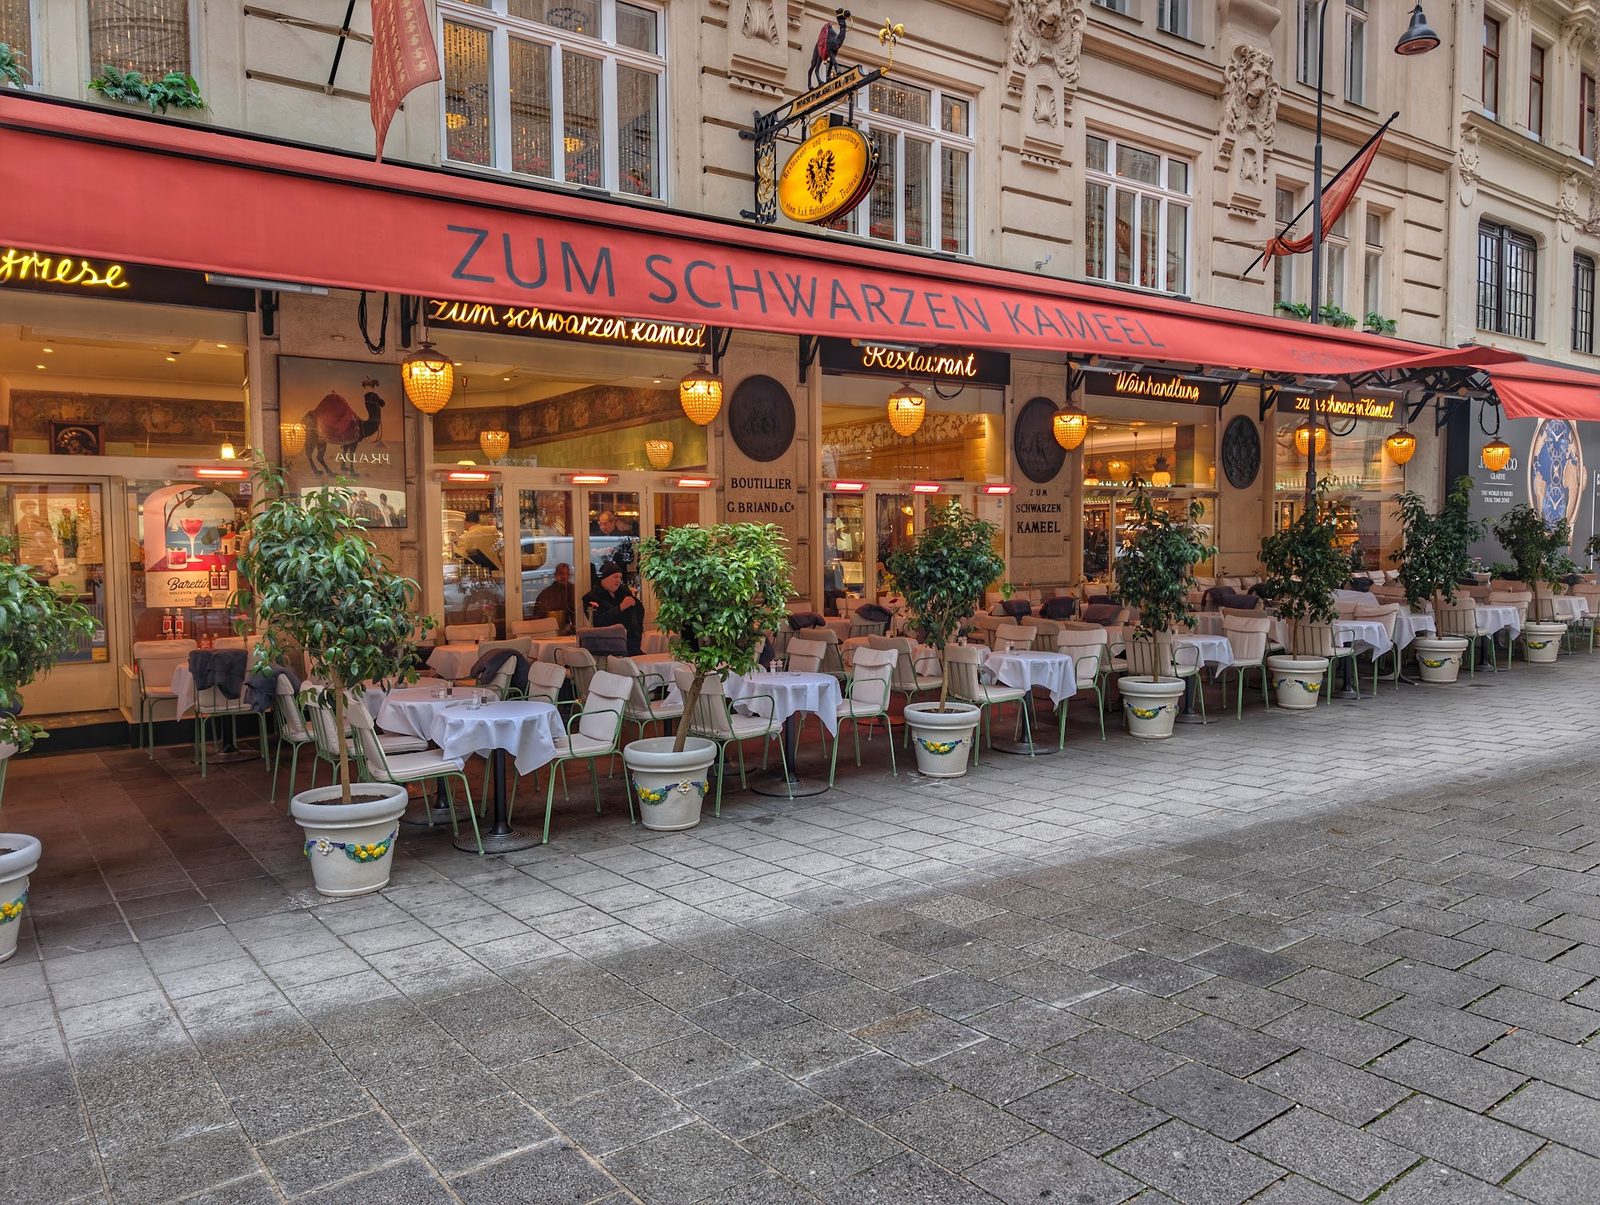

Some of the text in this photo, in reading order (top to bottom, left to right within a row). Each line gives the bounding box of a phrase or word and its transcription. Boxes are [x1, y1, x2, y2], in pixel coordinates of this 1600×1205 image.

[447, 224, 1165, 349] ZUM SCHWARZEN KAMEEL
[502, 307, 628, 340] schwarzen
[863, 346, 977, 377] Restaurant
[1114, 371, 1200, 402] Weinhandlung
[731, 477, 792, 490] BOUTILLIER
[1030, 489, 1048, 497] ZUM
[1016, 503, 1062, 513] SCHWARZEN
[1017, 521, 1061, 534] KAMEEL
